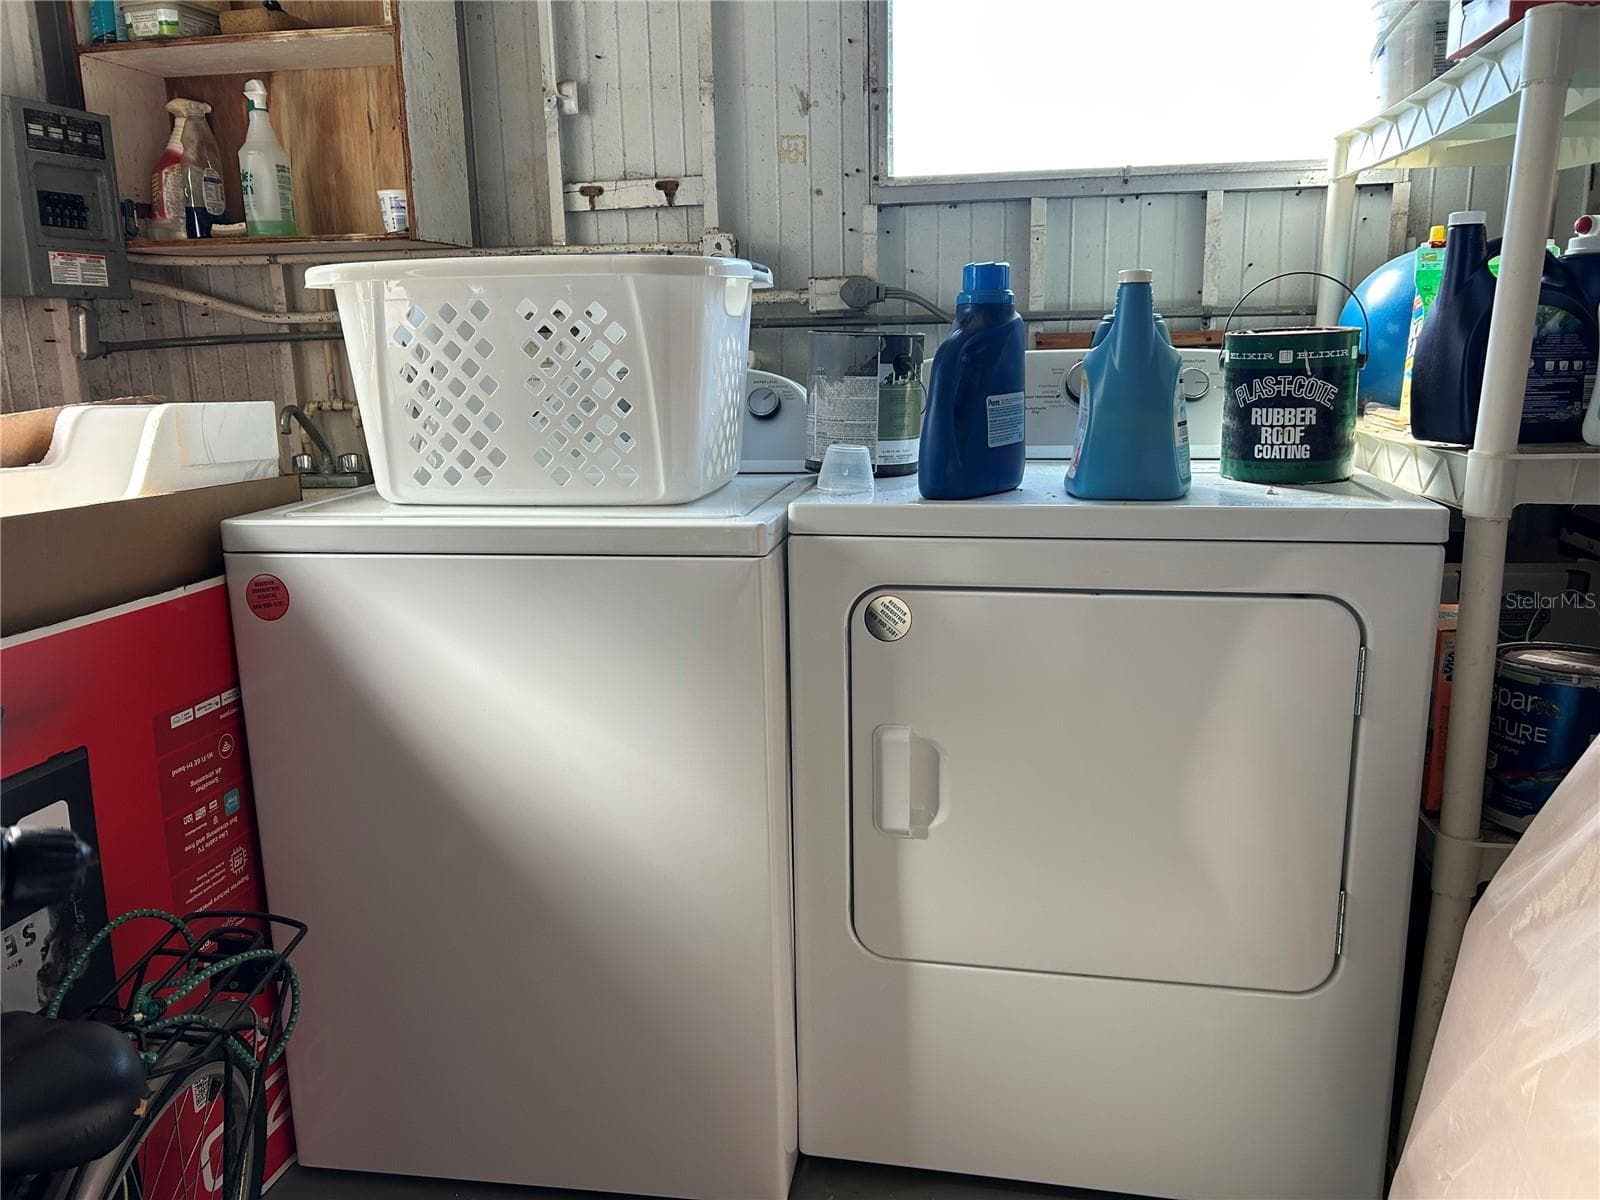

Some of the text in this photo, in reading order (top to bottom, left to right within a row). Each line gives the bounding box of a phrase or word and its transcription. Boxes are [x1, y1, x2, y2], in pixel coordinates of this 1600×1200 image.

[1230, 352, 1275, 360] ELIXIR
[1296, 349, 1349, 360] ELIXIR
[1251, 407, 1317, 426] RUBBER
[1260, 426, 1305, 444] ROOF
[1254, 444, 1311, 459] COATING
